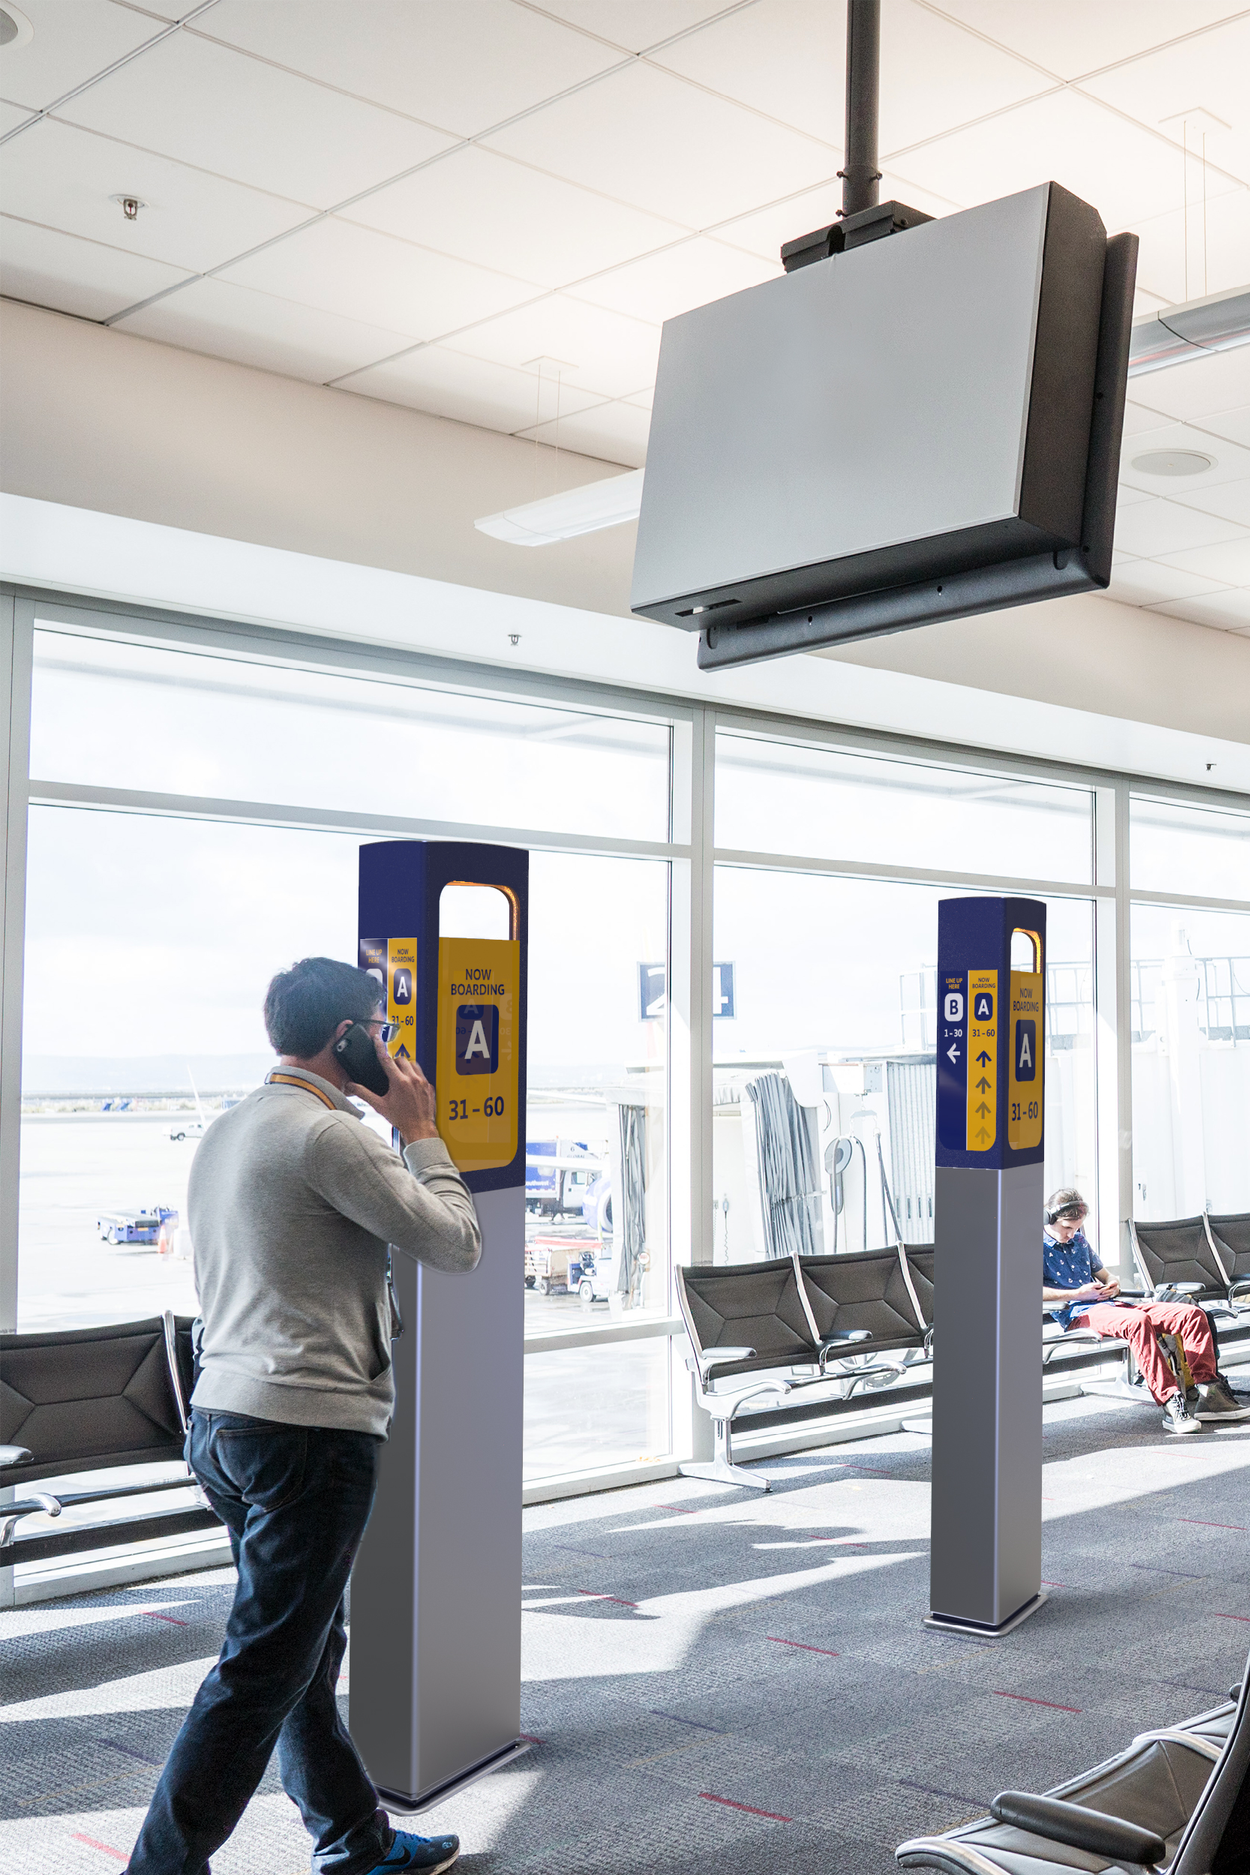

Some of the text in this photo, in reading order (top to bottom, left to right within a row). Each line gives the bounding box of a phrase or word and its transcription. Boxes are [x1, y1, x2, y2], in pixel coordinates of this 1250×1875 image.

[368, 956, 380, 964] HERE
[465, 968, 492, 980] NOW
[397, 976, 408, 997] A
[451, 984, 505, 996] BOARDING
[1020, 988, 1033, 998] NOW
[950, 1000, 959, 1015] B
[977, 999, 990, 1015] A
[1013, 1001, 1039, 1012] BOARDING
[464, 1020, 490, 1060] A
[1019, 1034, 1032, 1068] A
